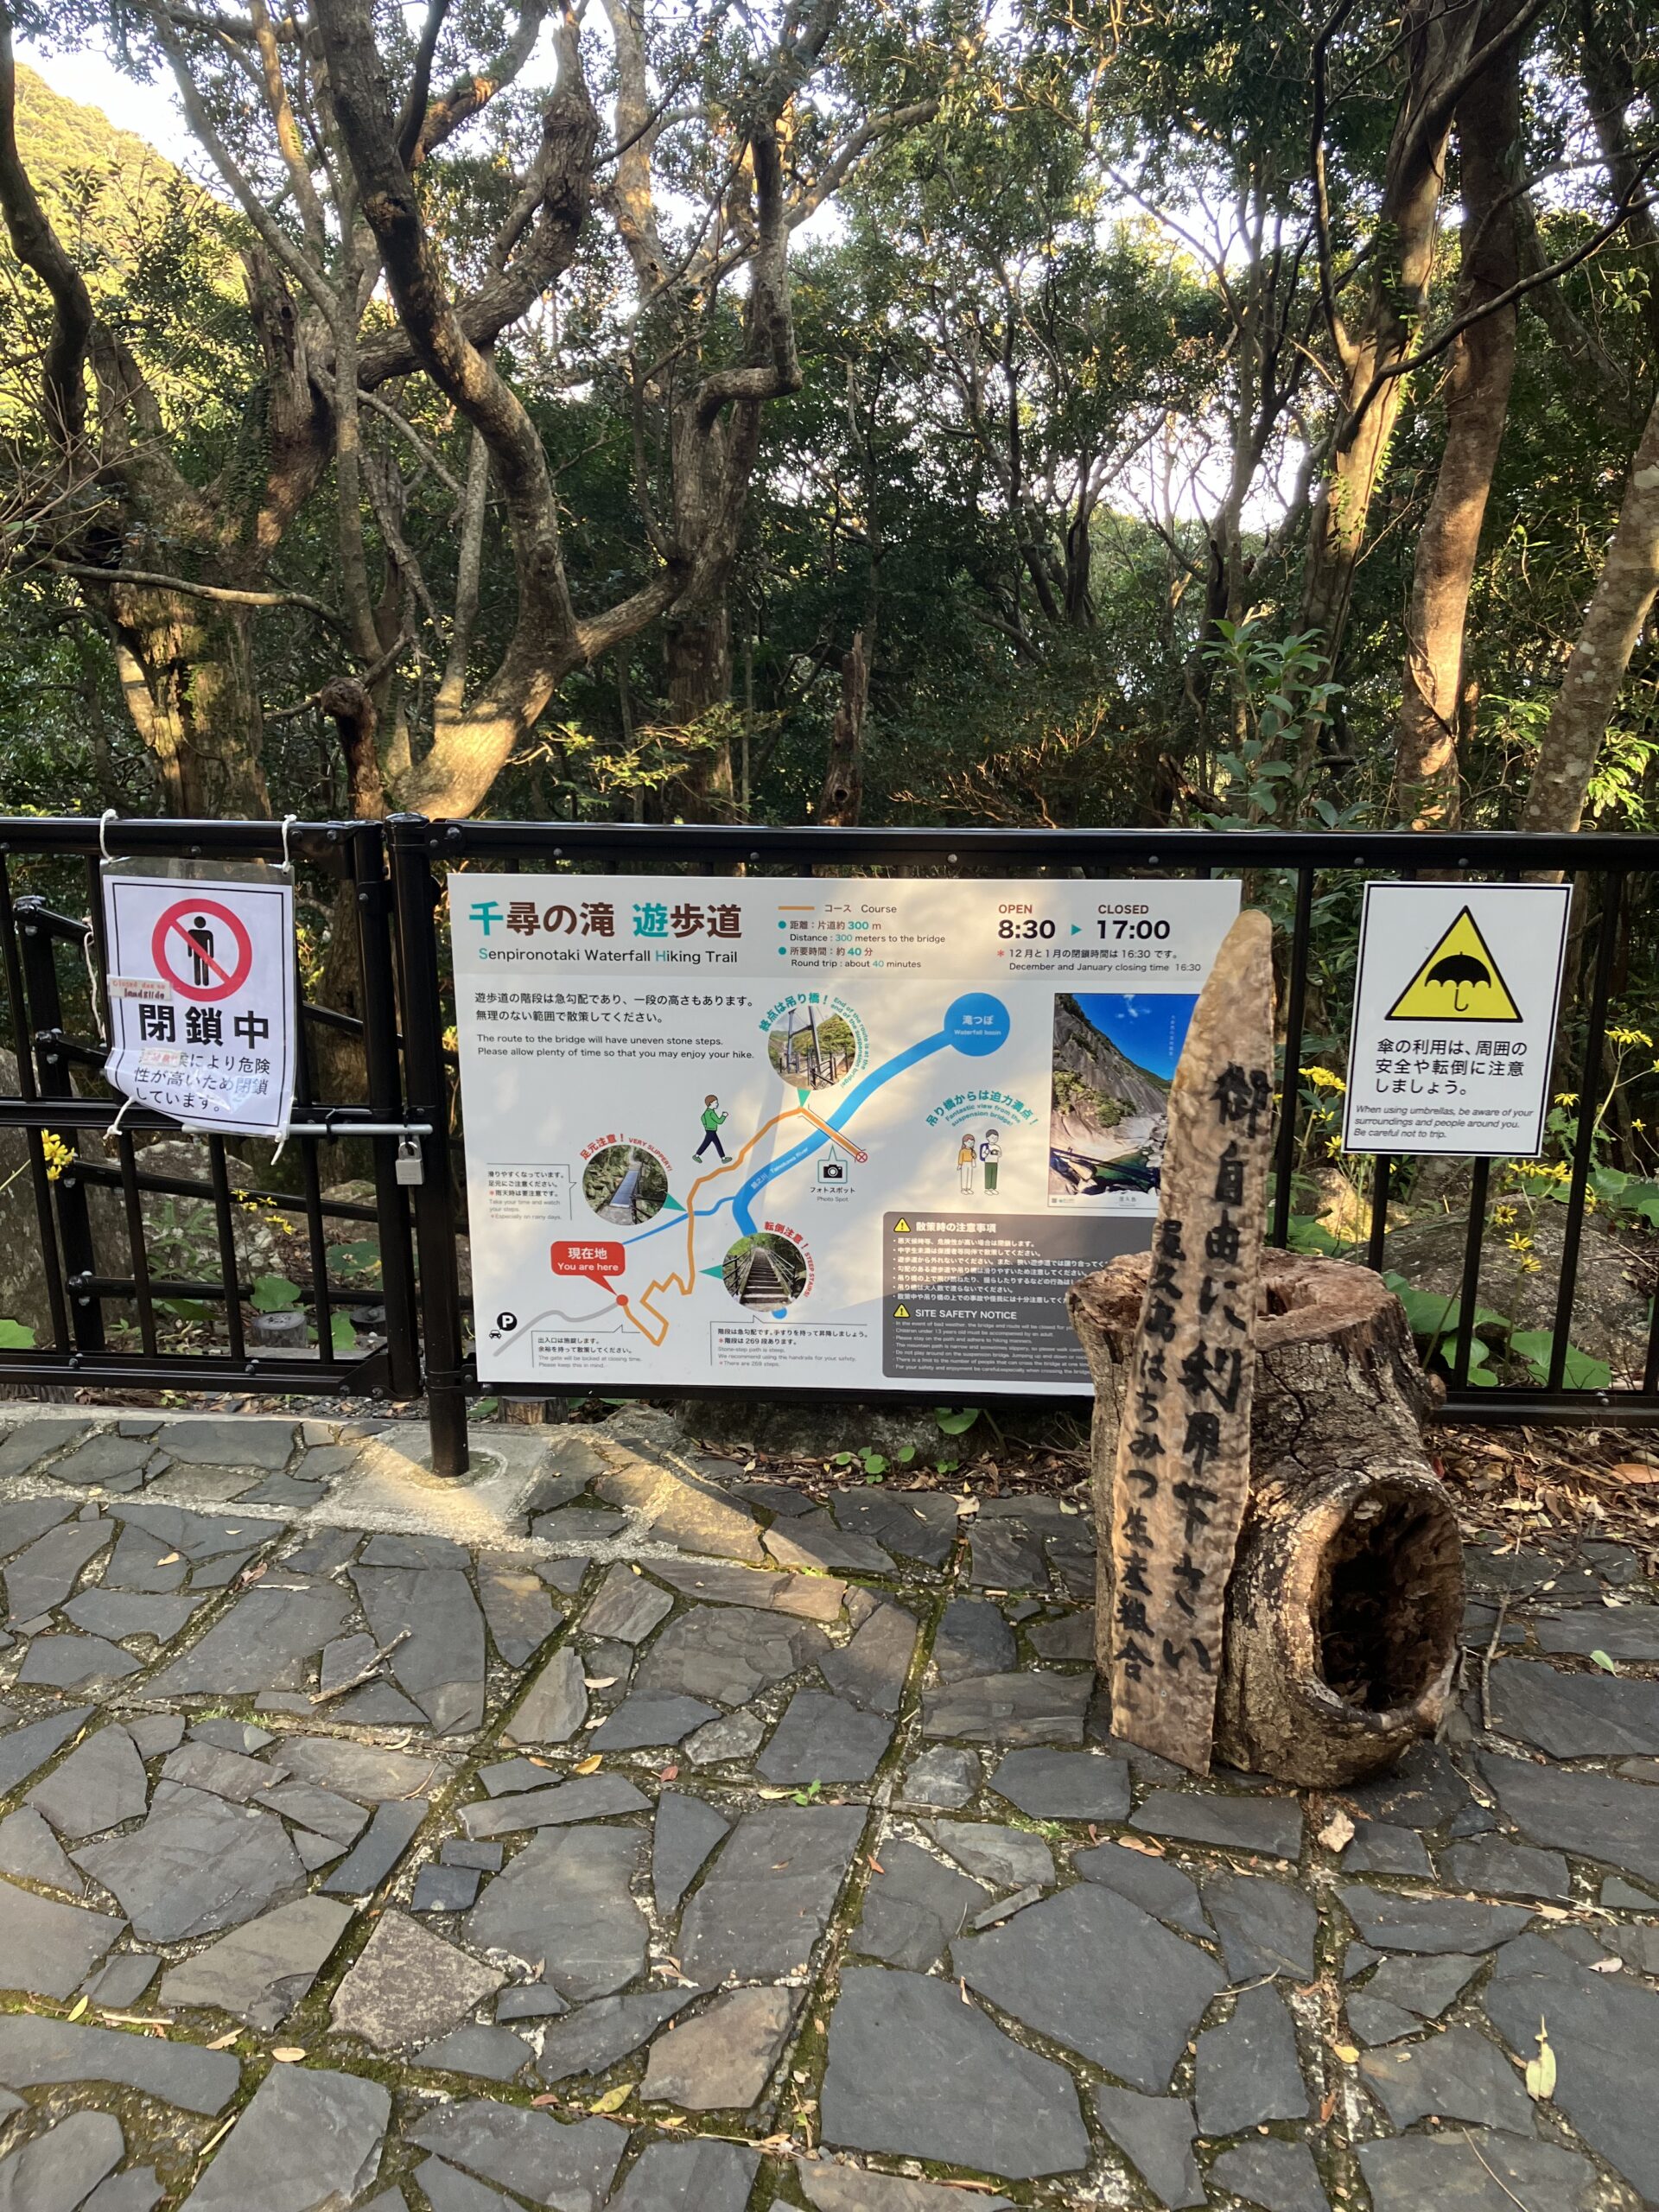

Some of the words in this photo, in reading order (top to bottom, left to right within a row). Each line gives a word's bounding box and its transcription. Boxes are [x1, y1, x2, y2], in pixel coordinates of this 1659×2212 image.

[824, 905, 852, 913] コース
[861, 904, 897, 913] Course
[998, 904, 1033, 914] OPEN
[1098, 905, 1149, 915] CLOSED
[469, 901, 615, 938] 千尋の滝
[632, 903, 742, 938] 遊歩道
[997, 919, 1056, 939] 8:30
[1096, 919, 1171, 940] 17:00
[790, 933, 828, 942] Distance
[916, 934, 945, 943] bridge
[479, 948, 580, 963] Senpironotaki
[584, 949, 650, 961] Waterfall
[656, 950, 701, 964] Hiking
[704, 950, 737, 963] Trail
[791, 959, 819, 967] Round
[821, 959, 837, 968] trip
[1009, 963, 1055, 971] December
[1076, 963, 1112, 972] January
[1115, 963, 1146, 972] closing
[474, 992, 754, 1007] 遊歩道の階段は急勾配であり、一段の高さもあります。
[476, 1009, 664, 1024] 無理のない範囲で散策してください。
[962, 1014, 995, 1026] 滝つぼ
[138, 1003, 269, 1049] 閉鎖中
[555, 1035, 585, 1044] bridge
[695, 1038, 722, 1046] steps.
[536, 1048, 565, 1057] plenty
[680, 1050, 706, 1059] enjoy
[1376, 1038, 1528, 1057] 傘の利用は、周囲の
[1376, 1059, 1525, 1077] 安全や転倒に注意
[134, 1066, 269, 1096] 性が高いため閉鎖
[1376, 1078, 1467, 1096] しましょう。
[135, 1088, 220, 1113] しています。
[1383, 1106, 1408, 1115] using
[1409, 1106, 1455, 1115] umbrellas,
[1354, 1118, 1413, 1127] surroundings
[1433, 1119, 1465, 1128] people
[1429, 1130, 1446, 1139] trip.
[629, 1137, 648, 1147] VERY
[916, 1222, 996, 1234] 散策時の注意事項
[568, 1247, 607, 1260] 現在地
[804, 1252, 815, 1272] STEEP
[939, 1310, 977, 1318] SAFETY
[980, 1311, 1017, 1319] NOTICE
[501, 1314, 514, 1328] P
